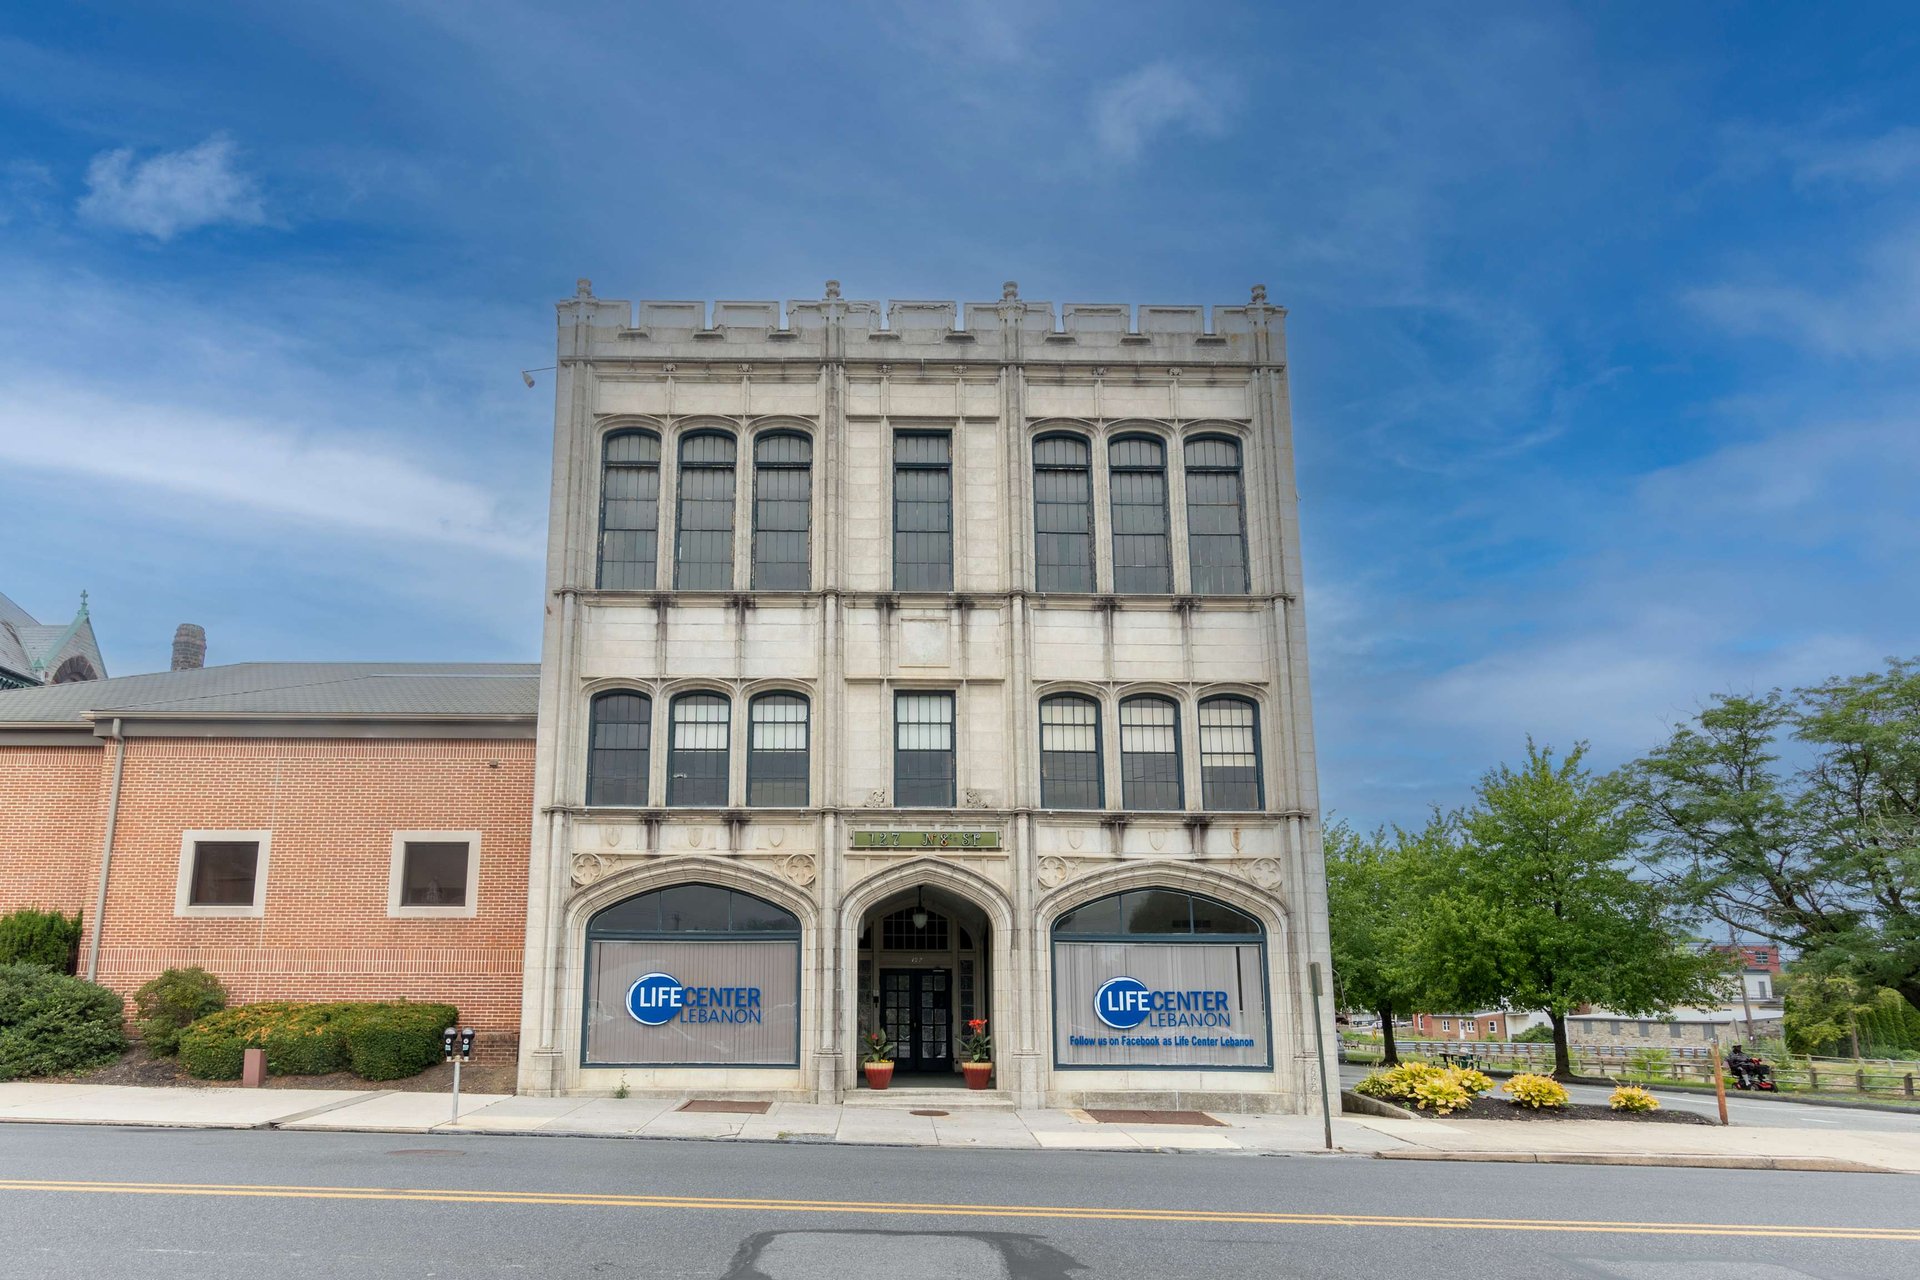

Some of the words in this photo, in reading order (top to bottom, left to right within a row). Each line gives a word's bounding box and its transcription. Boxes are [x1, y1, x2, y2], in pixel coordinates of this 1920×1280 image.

[869, 833, 900, 846] 127
[921, 833, 937, 846] N
[640, 987, 682, 1007] LIFE
[683, 986, 761, 1007] CENTER
[1107, 991, 1150, 1011] LIFE
[1150, 990, 1229, 1011] CENTER
[680, 1008, 761, 1024] LEBANON
[1149, 1012, 1231, 1027] LEBANON
[1069, 1035, 1096, 1046] Follow
[1097, 1037, 1108, 1046] us
[1109, 1037, 1120, 1046] on
[1121, 1035, 1160, 1046] Facebook
[1162, 1037, 1173, 1046] as
[1174, 1035, 1190, 1046] Life
[1191, 1036, 1219, 1047] Center
[1220, 1036, 1254, 1047] Lebanon
